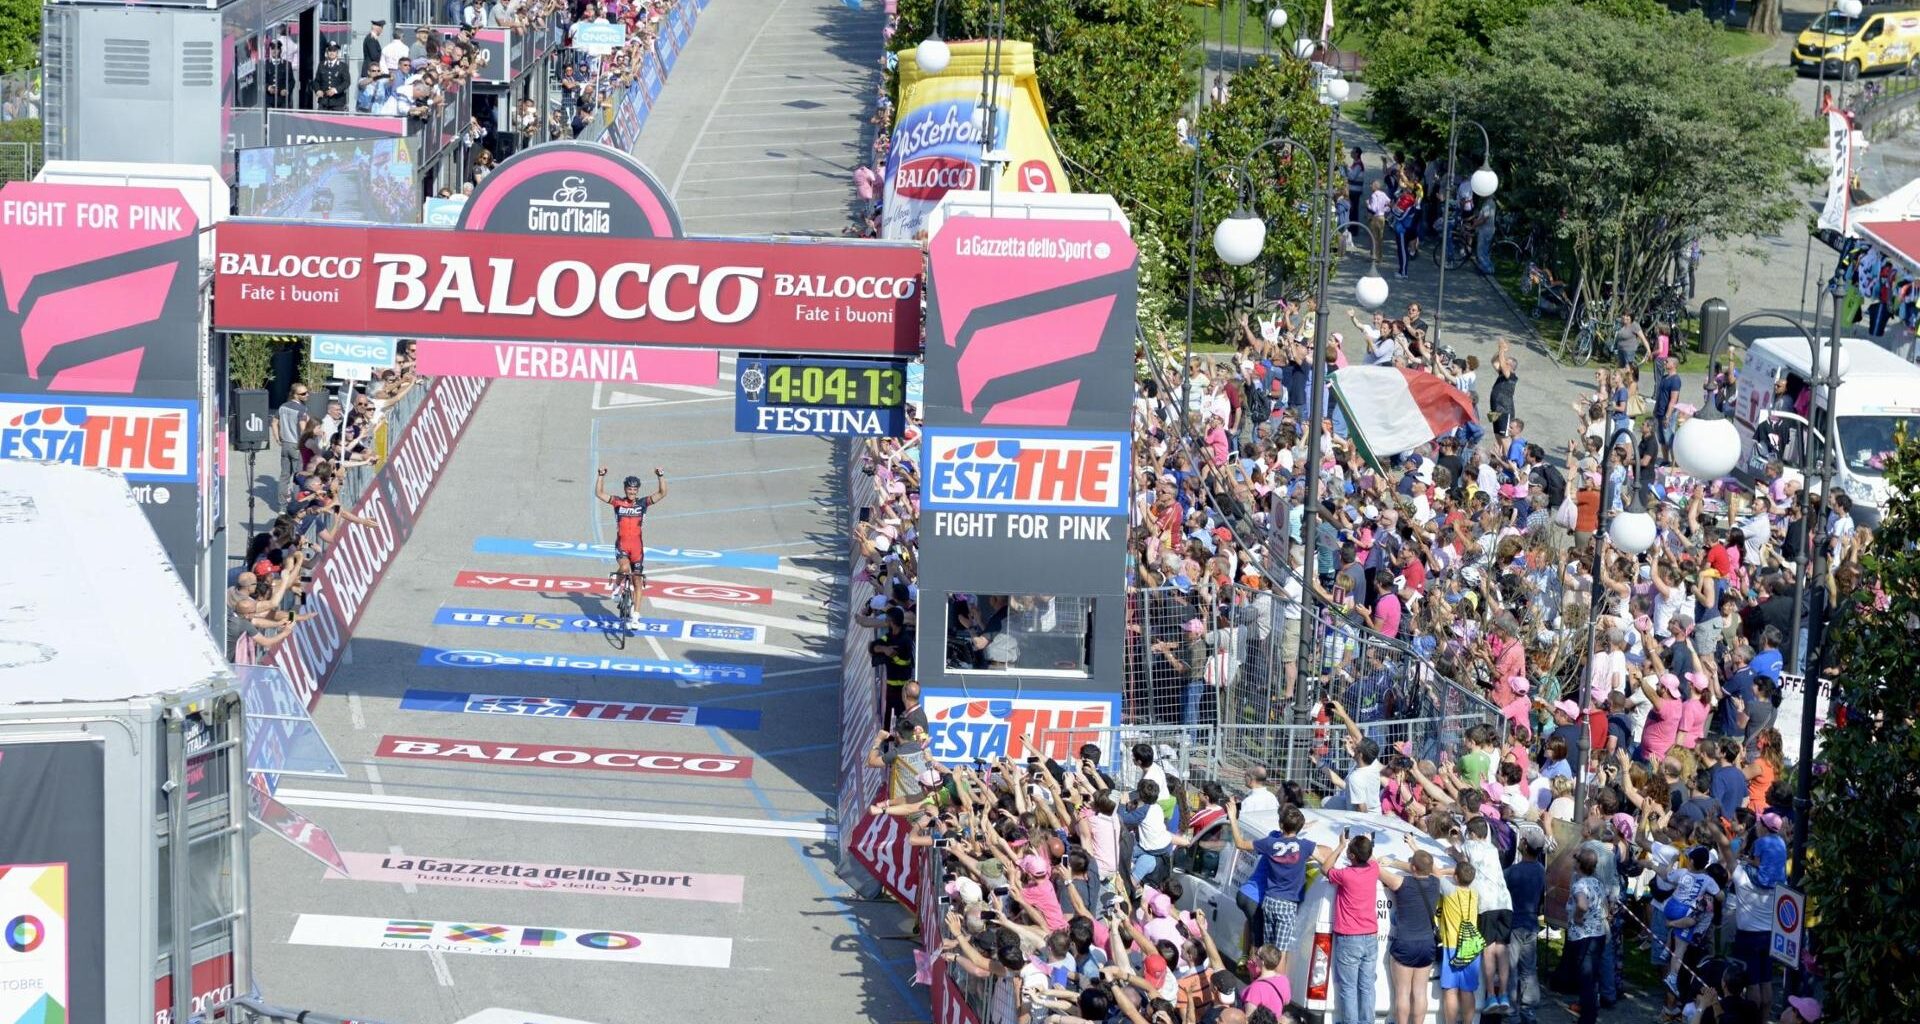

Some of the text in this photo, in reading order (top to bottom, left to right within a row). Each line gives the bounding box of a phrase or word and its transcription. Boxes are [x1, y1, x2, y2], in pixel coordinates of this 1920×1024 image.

[896, 168, 973, 189] BALOCCO
[4, 200, 183, 231] FIGHT FOR PINK
[528, 207, 610, 234] Giro d'Italia
[956, 236, 1092, 262] La Gazzetta dello Sport
[219, 253, 362, 279] BALOCCO
[241, 284, 339, 303] Fate i buoni
[373, 253, 764, 322] BALOCCO
[774, 273, 917, 300] BALOCCO
[796, 304, 894, 323] Fate i buoni
[495, 345, 638, 379] VERBANIA
[756, 406, 884, 435] FESTINA
[394, 398, 449, 514] BALOCCO
[935, 512, 1111, 541] FIGHT FOR PINK
[450, 652, 747, 681] mediolanum
[393, 740, 741, 773] BALOCCO
[381, 858, 692, 887] La Gazzetta dello Sport
[415, 873, 463, 883] Tutto
[479, 878, 519, 886] rosa
[562, 882, 607, 891] della
[611, 884, 645, 893] vita
[380, 941, 534, 956] MILANO 2015
[383, 920, 642, 950] EXPO
